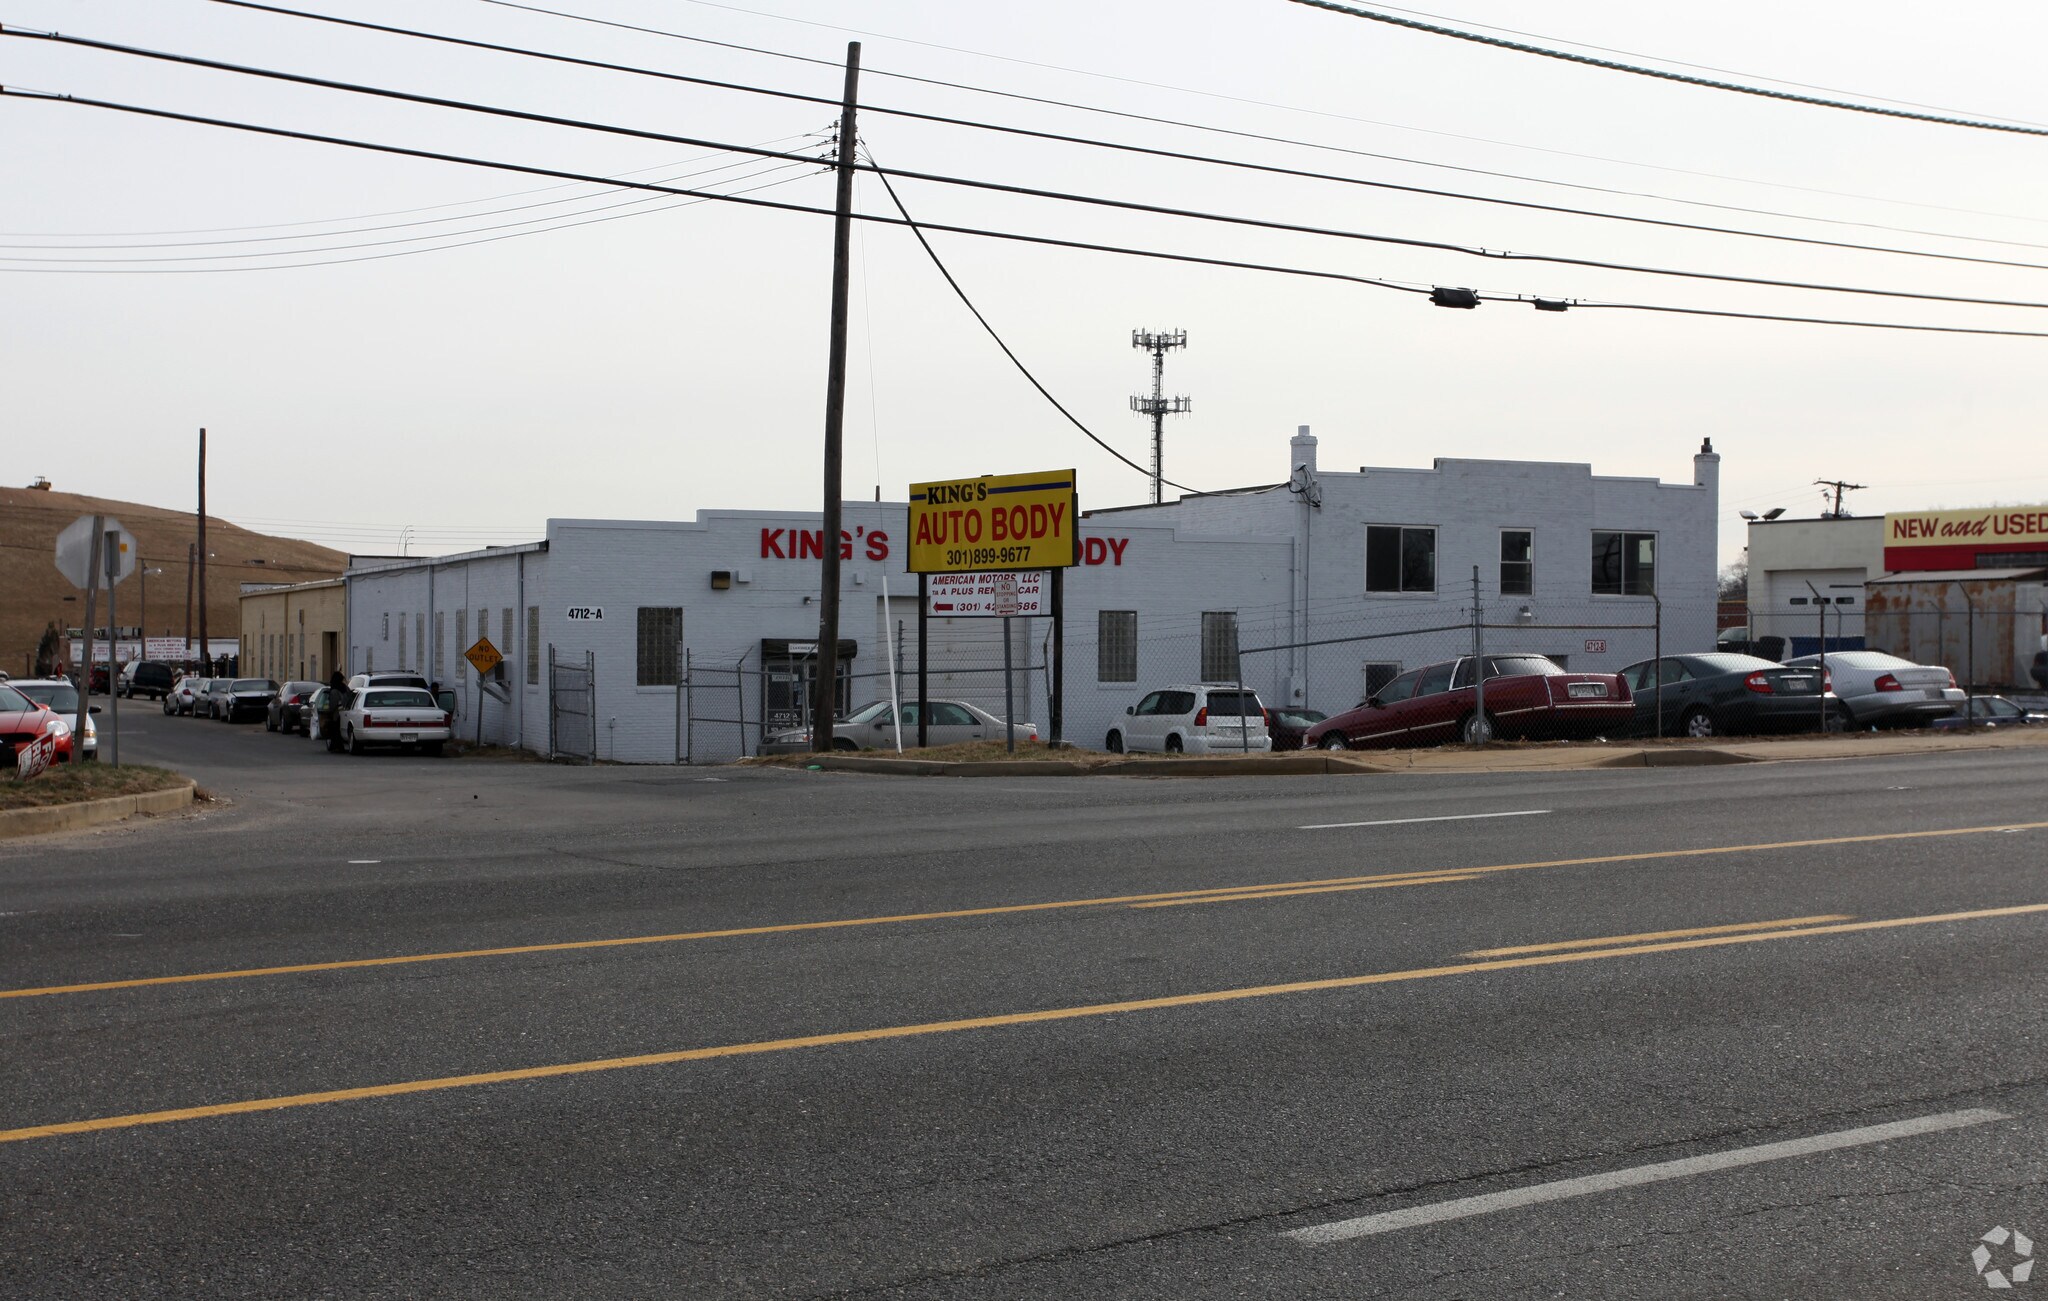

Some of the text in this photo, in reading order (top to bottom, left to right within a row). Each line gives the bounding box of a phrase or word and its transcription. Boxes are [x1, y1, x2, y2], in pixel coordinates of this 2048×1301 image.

[927, 482, 988, 505] KING'S
[916, 502, 1066, 546] AUTO BODY
[1893, 518, 1939, 539] NEW
[1941, 514, 1991, 538] and
[946, 546, 1031, 569] 301)899-9677
[1078, 537, 1129, 566] DY
[932, 574, 975, 586] AMERICAN
[1022, 573, 1040, 584] LLC
[951, 587, 974, 595] PLUS
[978, 586, 995, 595] REN
[1018, 586, 1039, 594] CAR
[956, 602, 980, 611] (301)
[568, 608, 602, 619] 4712-A
[1587, 642, 1604, 651] 4712-B
[469, 654, 498, 663] OUTLET
